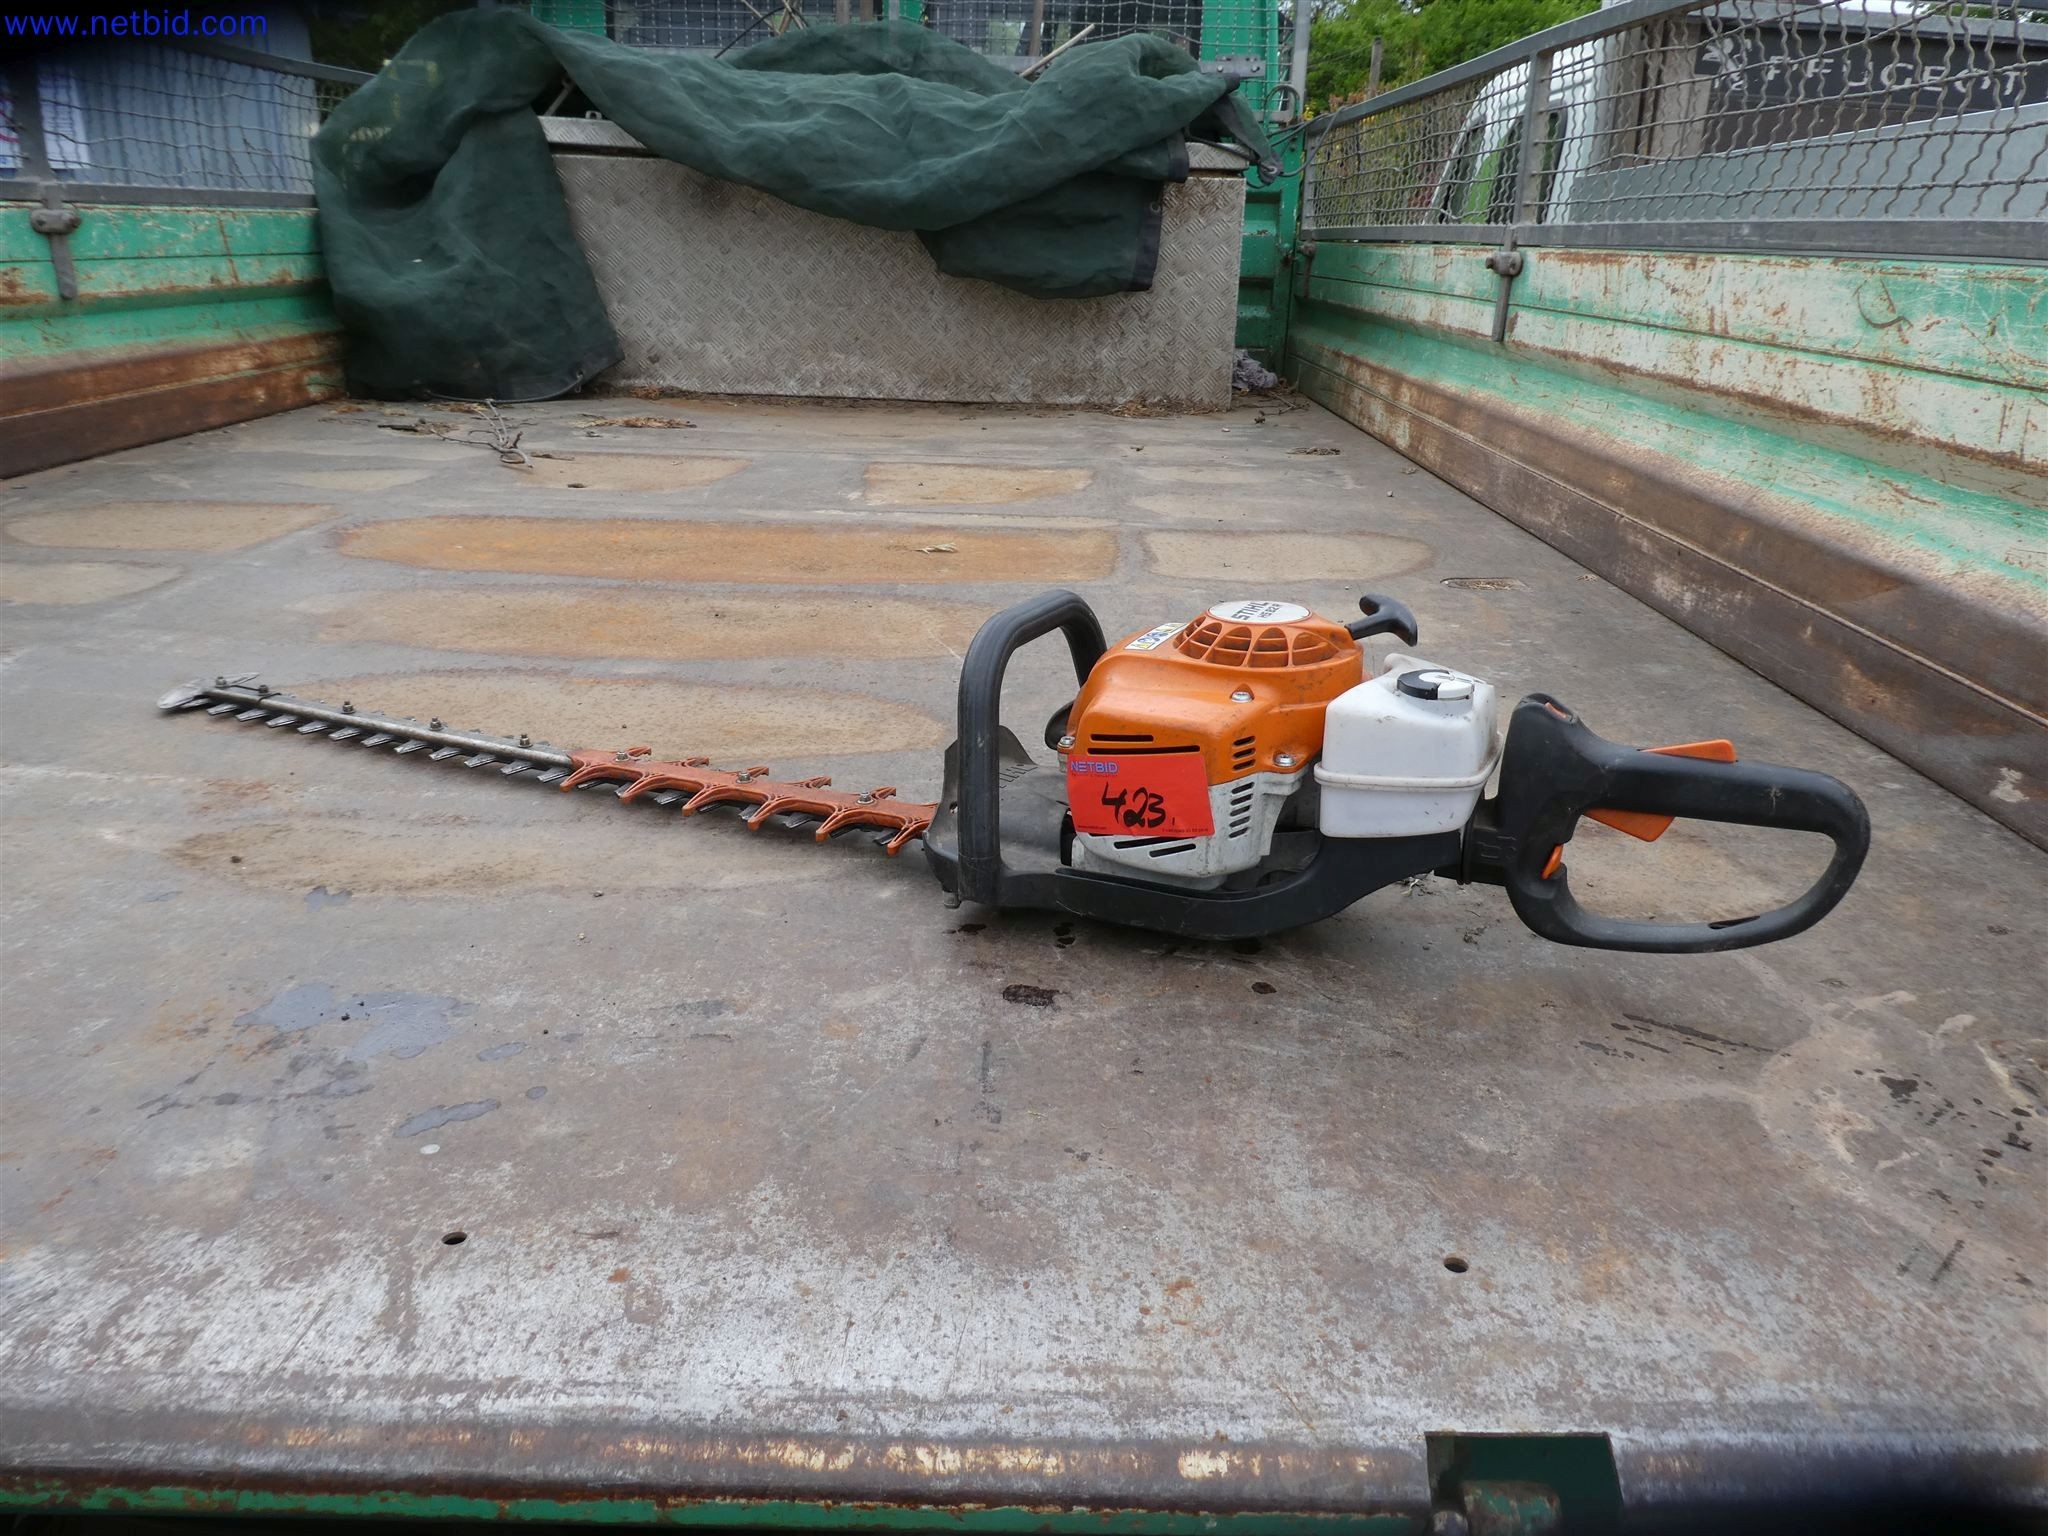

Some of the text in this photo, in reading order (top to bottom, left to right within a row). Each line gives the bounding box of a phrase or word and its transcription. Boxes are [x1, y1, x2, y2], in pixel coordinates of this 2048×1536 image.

[1231, 602, 1269, 620] STIHL
[1071, 761, 1118, 774] NETBID
[1101, 781, 1166, 828] 423
